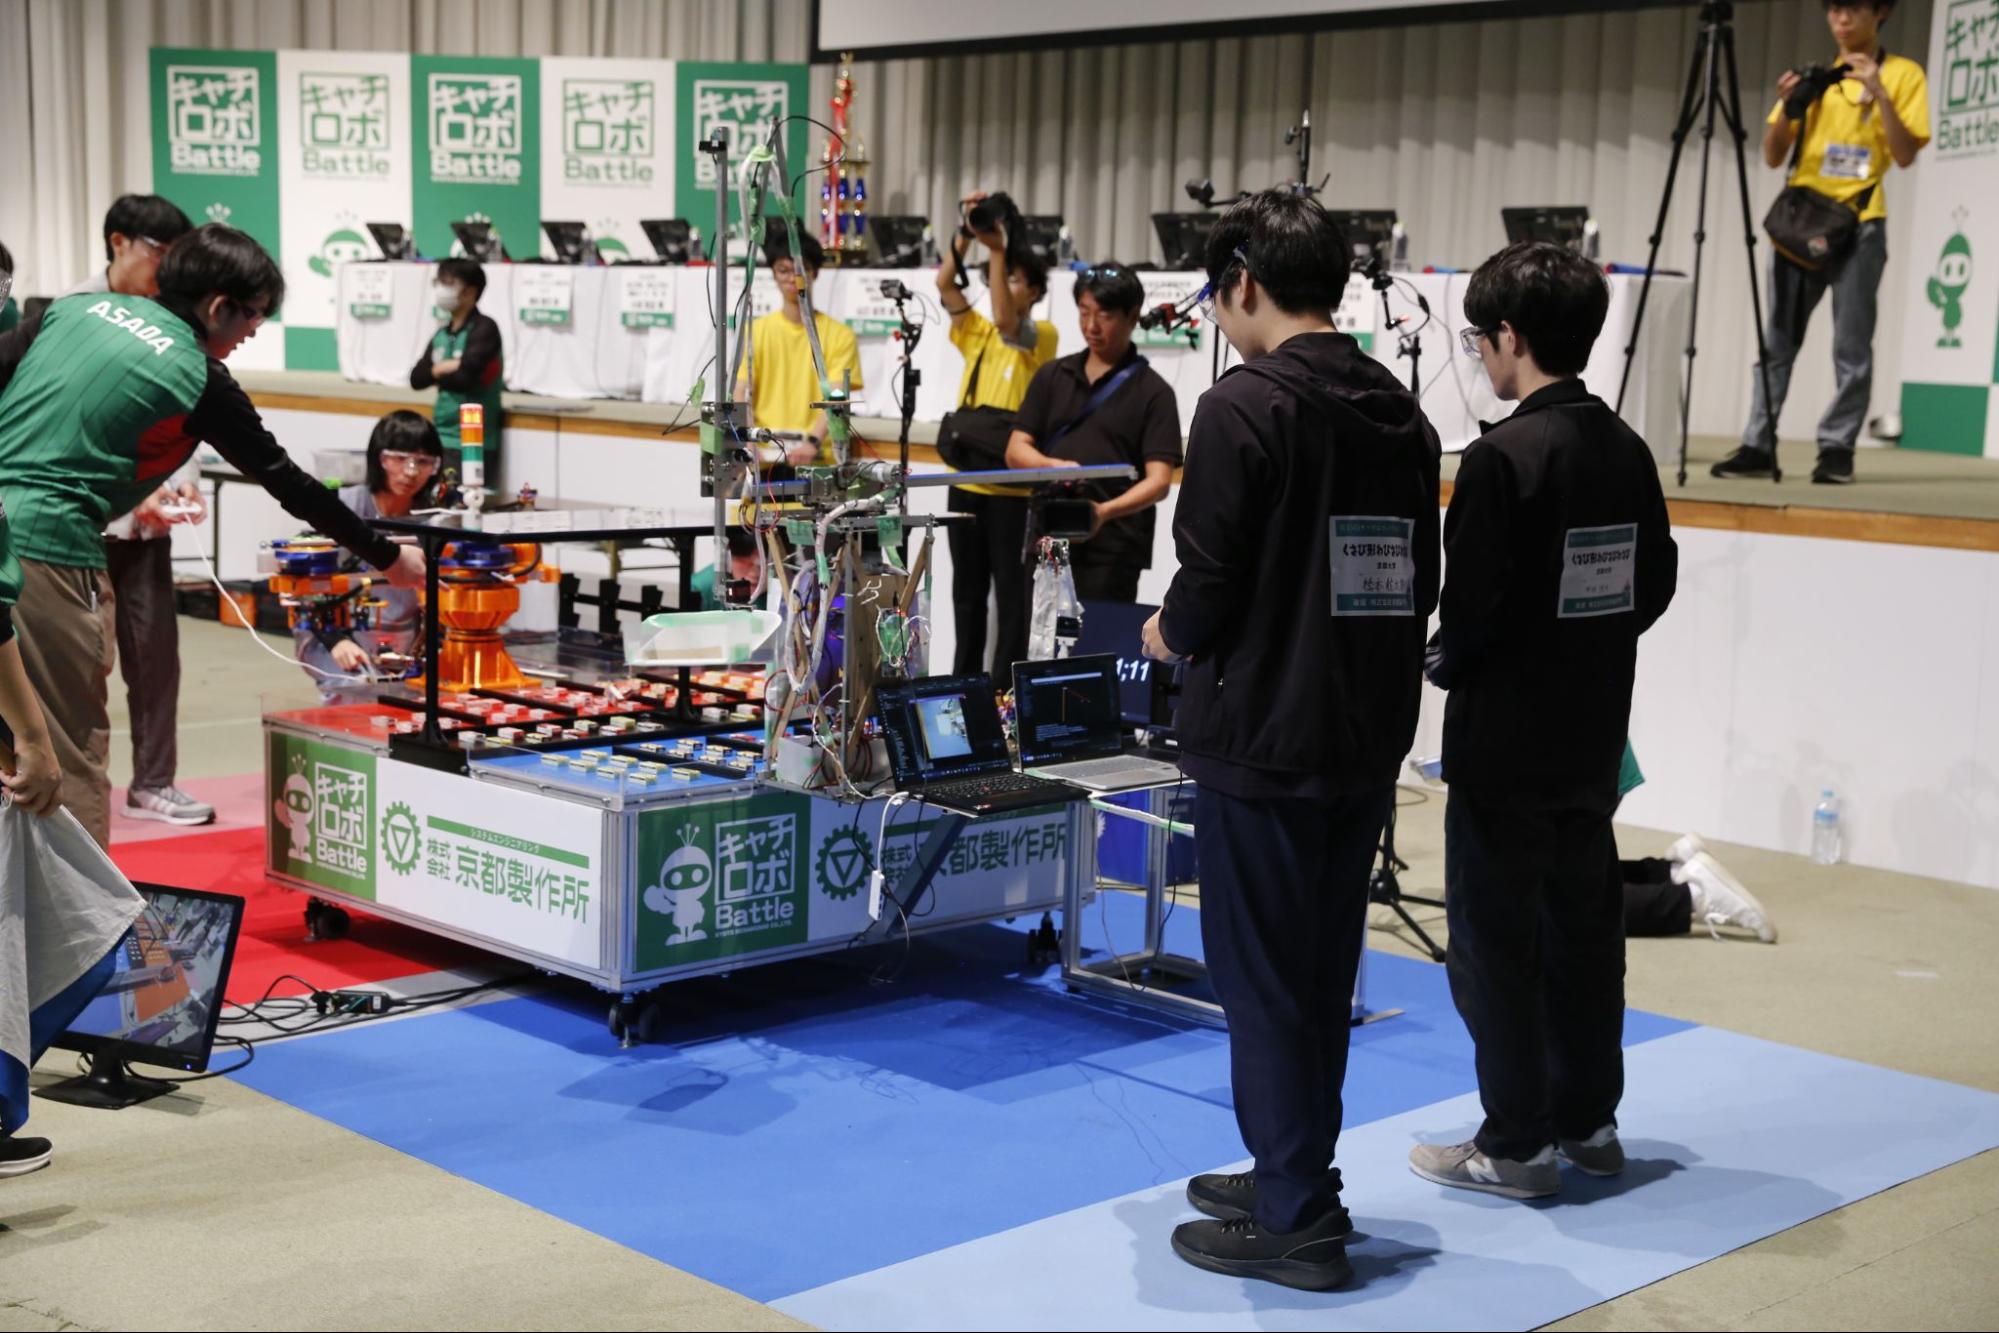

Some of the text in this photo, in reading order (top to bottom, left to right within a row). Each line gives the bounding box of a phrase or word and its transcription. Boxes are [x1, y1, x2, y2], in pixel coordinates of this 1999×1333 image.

[172, 73, 254, 105] キャチ
[301, 75, 387, 112] キャチ
[434, 79, 519, 114] キャチ
[565, 83, 652, 118] キャチ
[179, 104, 252, 143] ロボ
[312, 109, 381, 144] ロボ
[440, 112, 514, 149] ロボ
[576, 117, 645, 153] ロボ
[171, 143, 260, 169] Battle
[302, 152, 389, 175] Battle
[431, 152, 521, 178] Battle
[564, 159, 653, 183] Battle
[87, 300, 175, 356] ASADA
[317, 774, 366, 805] キャチ
[320, 803, 365, 843] ロボ
[718, 816, 795, 864] キャチ
[316, 839, 368, 873] Battle
[427, 838, 451, 860] 株式
[919, 822, 1065, 879] 都製作所
[427, 857, 451, 881] 会社
[455, 844, 590, 924] 京都製作所
[724, 848, 791, 899] ロボ
[715, 896, 794, 930] Battle
